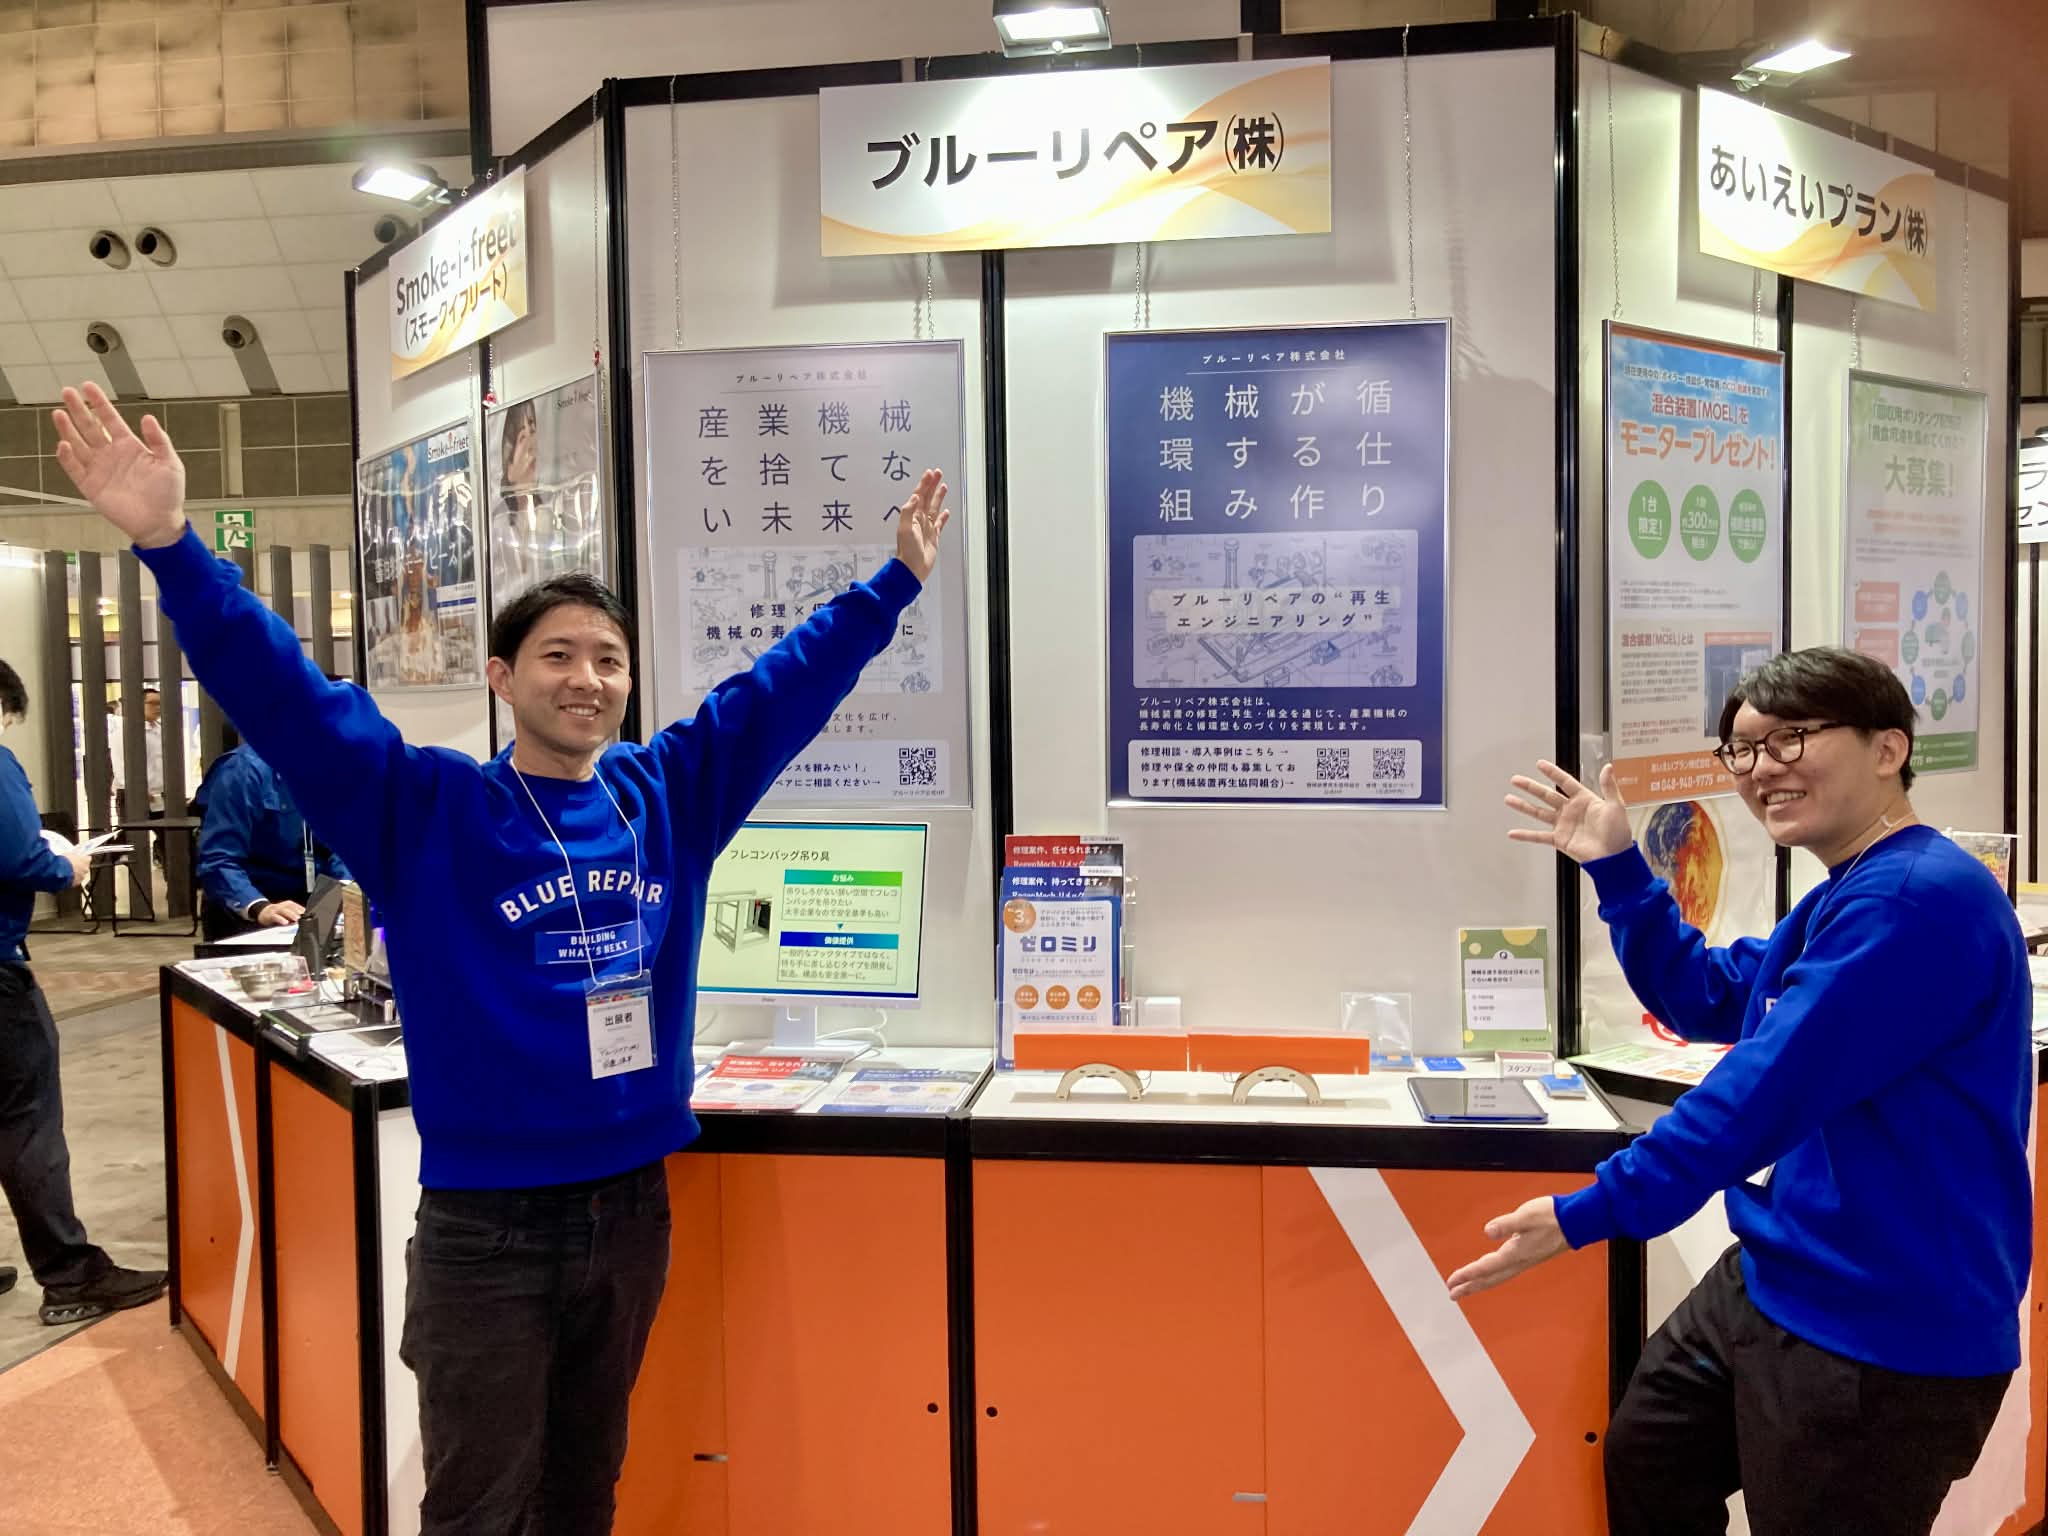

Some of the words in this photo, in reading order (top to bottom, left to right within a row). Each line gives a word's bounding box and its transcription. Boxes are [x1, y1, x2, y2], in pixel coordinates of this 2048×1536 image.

[867, 112, 1284, 190] ブルーリペア(株)
[1710, 144, 1928, 258] あいえいプラン(株)
[1203, 350, 1345, 364] ブルーリペア株式会社
[736, 370, 867, 384] ブルーリペア株式会社
[1159, 379, 1393, 422] 機械が循
[1651, 392, 1749, 424] 混合装置「MOEL」を
[698, 400, 912, 439] 産業機械
[1159, 431, 1393, 472] 環する仕
[1620, 421, 1776, 470] モニタープレゼント!
[701, 450, 911, 486] を捨てな
[1884, 455, 1953, 497] 大募集!
[702, 500, 901, 534] い未来へ
[1159, 483, 1386, 522] 組み作り
[1172, 590, 1391, 606] ブルーリペアの“再生
[1177, 613, 1373, 627] エンジニアリング”
[1139, 696, 1271, 706] ブルーリペア株式会社は、
[1141, 762, 1296, 773] 修理や保全の仲間も募集してお
[730, 849, 830, 862] フレコンバッグ吊り具
[500, 875, 576, 923] BLUE
[570, 930, 616, 945] BUILDING
[604, 940, 628, 954] NEXT
[1020, 936, 1097, 953] ゼロミリ
